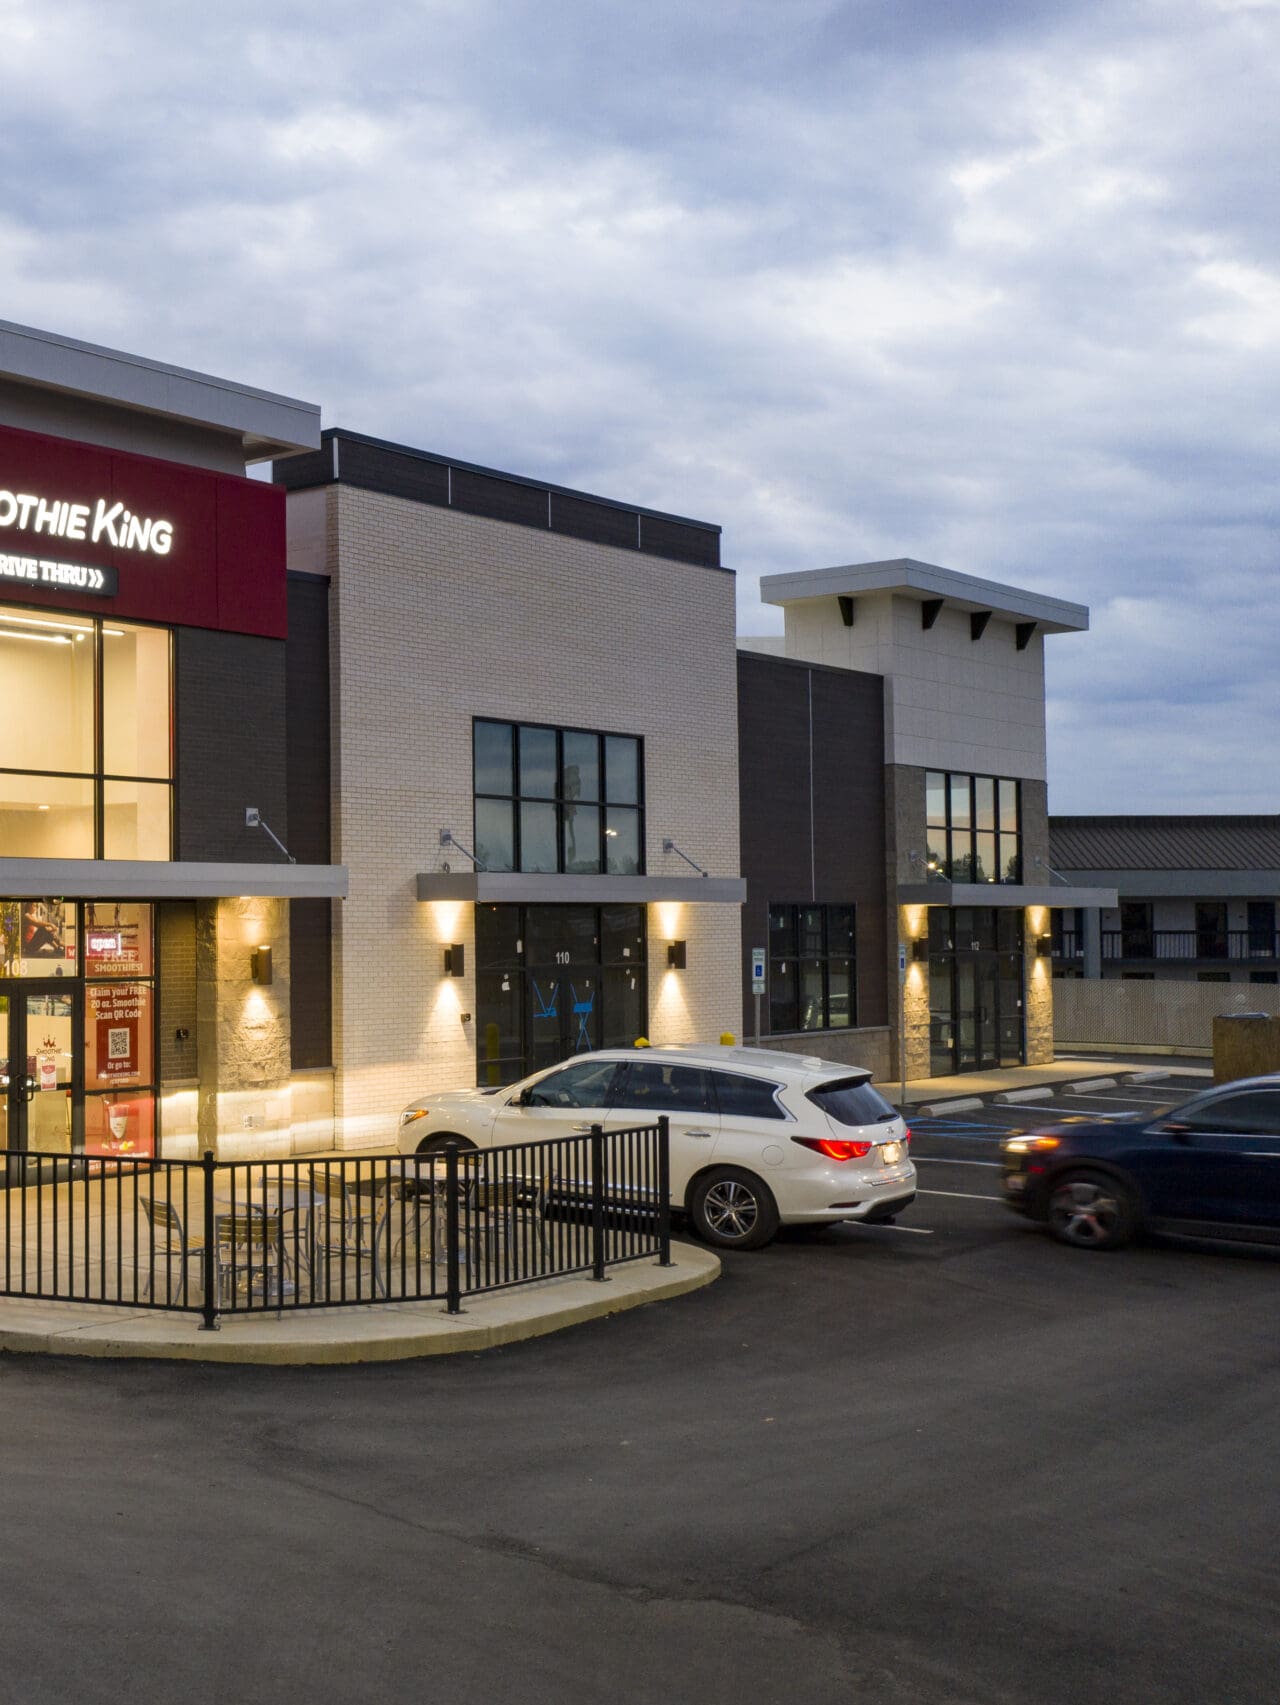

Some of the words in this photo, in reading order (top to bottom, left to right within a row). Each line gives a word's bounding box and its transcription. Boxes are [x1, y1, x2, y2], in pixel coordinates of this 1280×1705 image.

[39, 560, 87, 587] THRU
[103, 950, 136, 962] FREE
[556, 951, 570, 964] 110
[4, 960, 28, 976] 108
[94, 963, 144, 972] SMOOTHIES!
[90, 988, 111, 997] Claim
[112, 988, 129, 998] your
[129, 986, 147, 995] FREE
[91, 999, 101, 1009] 20
[101, 1000, 112, 1008] oz.
[112, 998, 146, 1007] Smoothie
[95, 1010, 113, 1020] Scan
[113, 1010, 124, 1020] QR
[124, 1009, 142, 1018] Code
[115, 1062, 123, 1070] go
